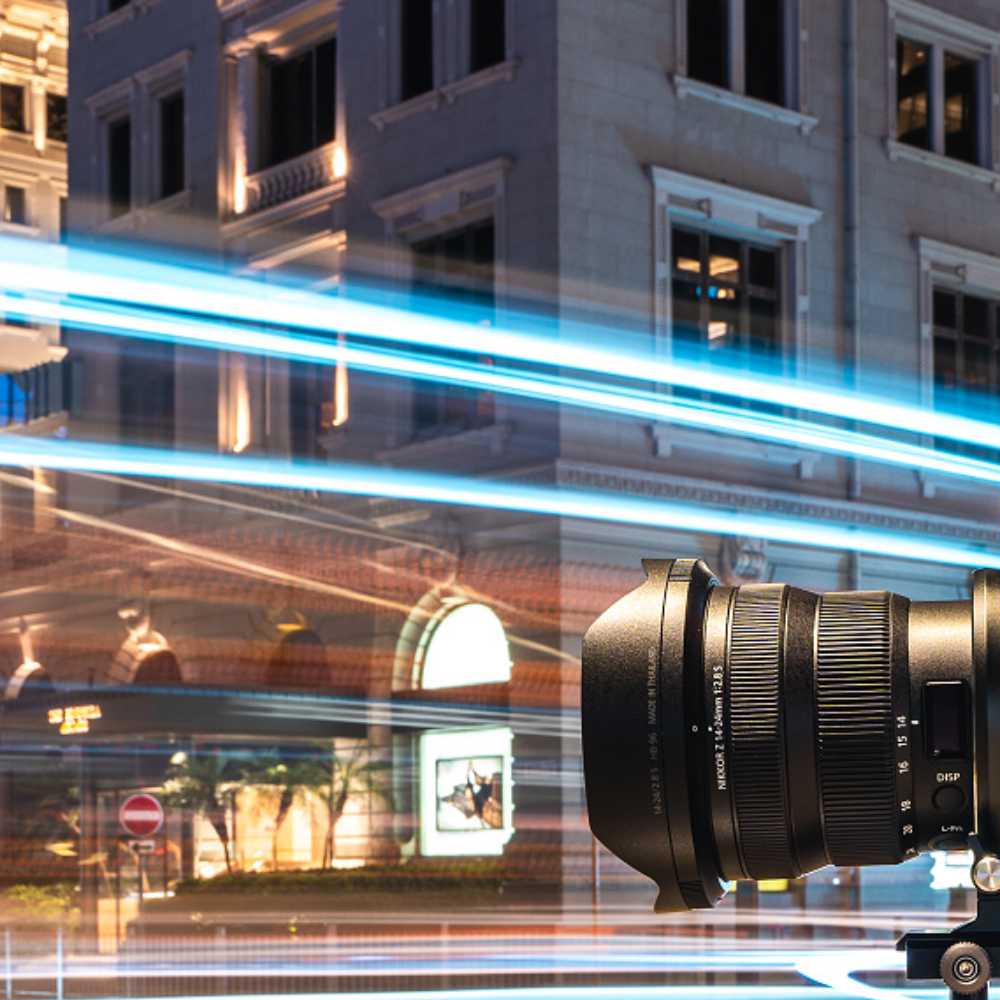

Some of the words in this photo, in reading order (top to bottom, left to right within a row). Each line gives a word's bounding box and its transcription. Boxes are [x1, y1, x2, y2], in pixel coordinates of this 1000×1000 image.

[714, 697, 723, 741] 14-24mm
[897, 735, 908, 747] 15
[897, 760, 909, 774] 16
[936, 772, 961, 782] DISP
